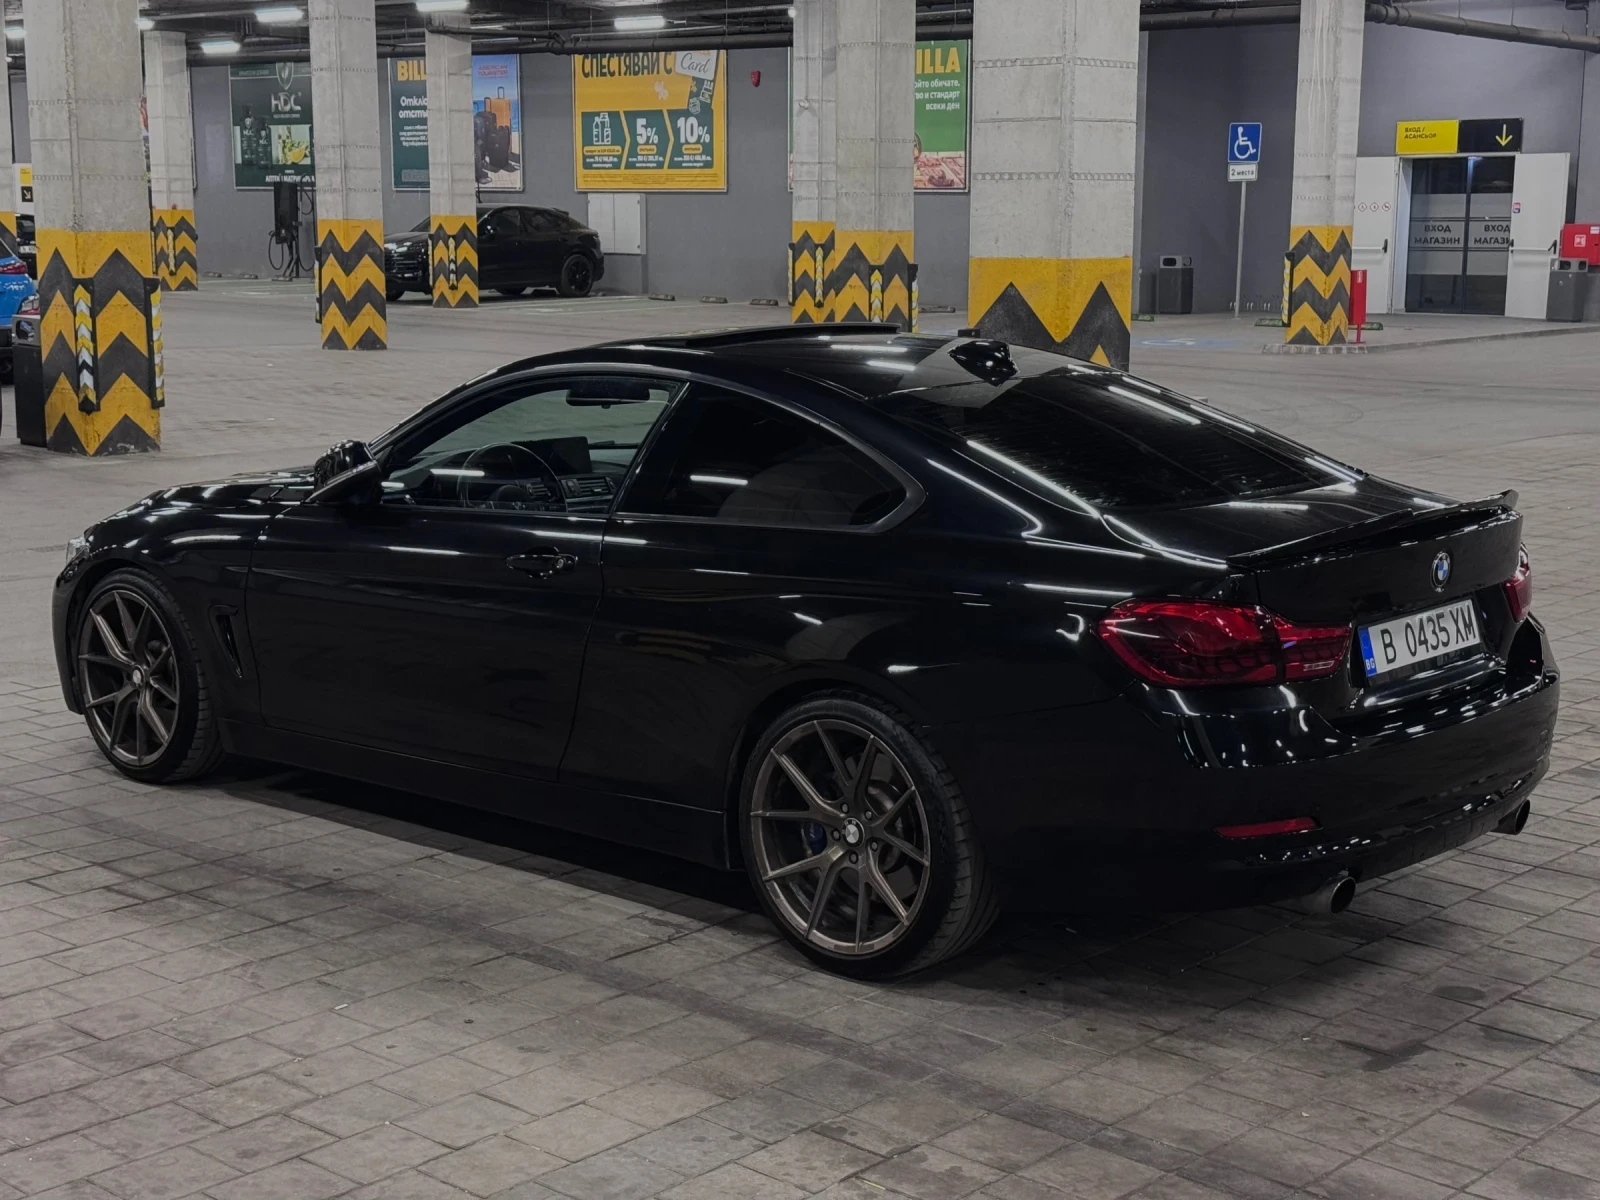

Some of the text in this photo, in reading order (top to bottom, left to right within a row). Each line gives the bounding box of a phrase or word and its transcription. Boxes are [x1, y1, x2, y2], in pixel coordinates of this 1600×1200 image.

[680, 52, 712, 73] Card
[915, 47, 961, 74] ILLA
[397, 60, 428, 81] BILL
[914, 79, 929, 88] ойто
[930, 91, 960, 101] стандарт
[925, 102, 960, 111] всеки ден
[636, 118, 659, 144] 5%
[677, 116, 710, 144] 10%
[1231, 168, 1236, 176] 2
[1424, 224, 1451, 233] ВХОД
[1484, 224, 1511, 233] ВХОД
[1414, 236, 1460, 244] МАГАЗИН
[1380, 604, 1477, 665] B 0435 XM
[1366, 658, 1376, 671] BG
